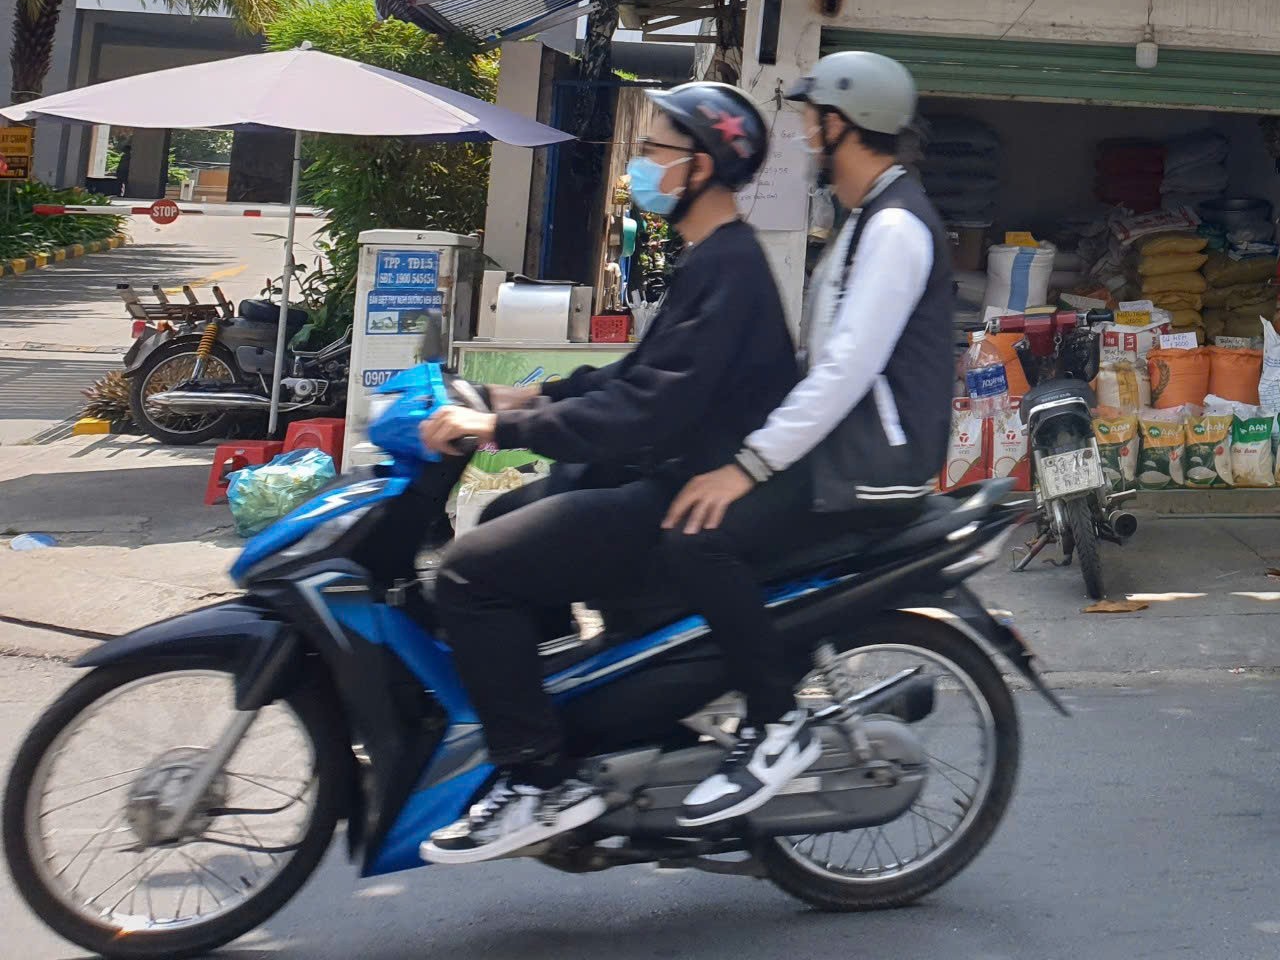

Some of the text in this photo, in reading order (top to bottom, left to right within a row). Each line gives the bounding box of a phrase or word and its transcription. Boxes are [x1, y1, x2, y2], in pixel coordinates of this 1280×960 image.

[152, 205, 178, 217] STOP
[384, 257, 400, 269] TPP
[1248, 424, 1268, 432] AAN
